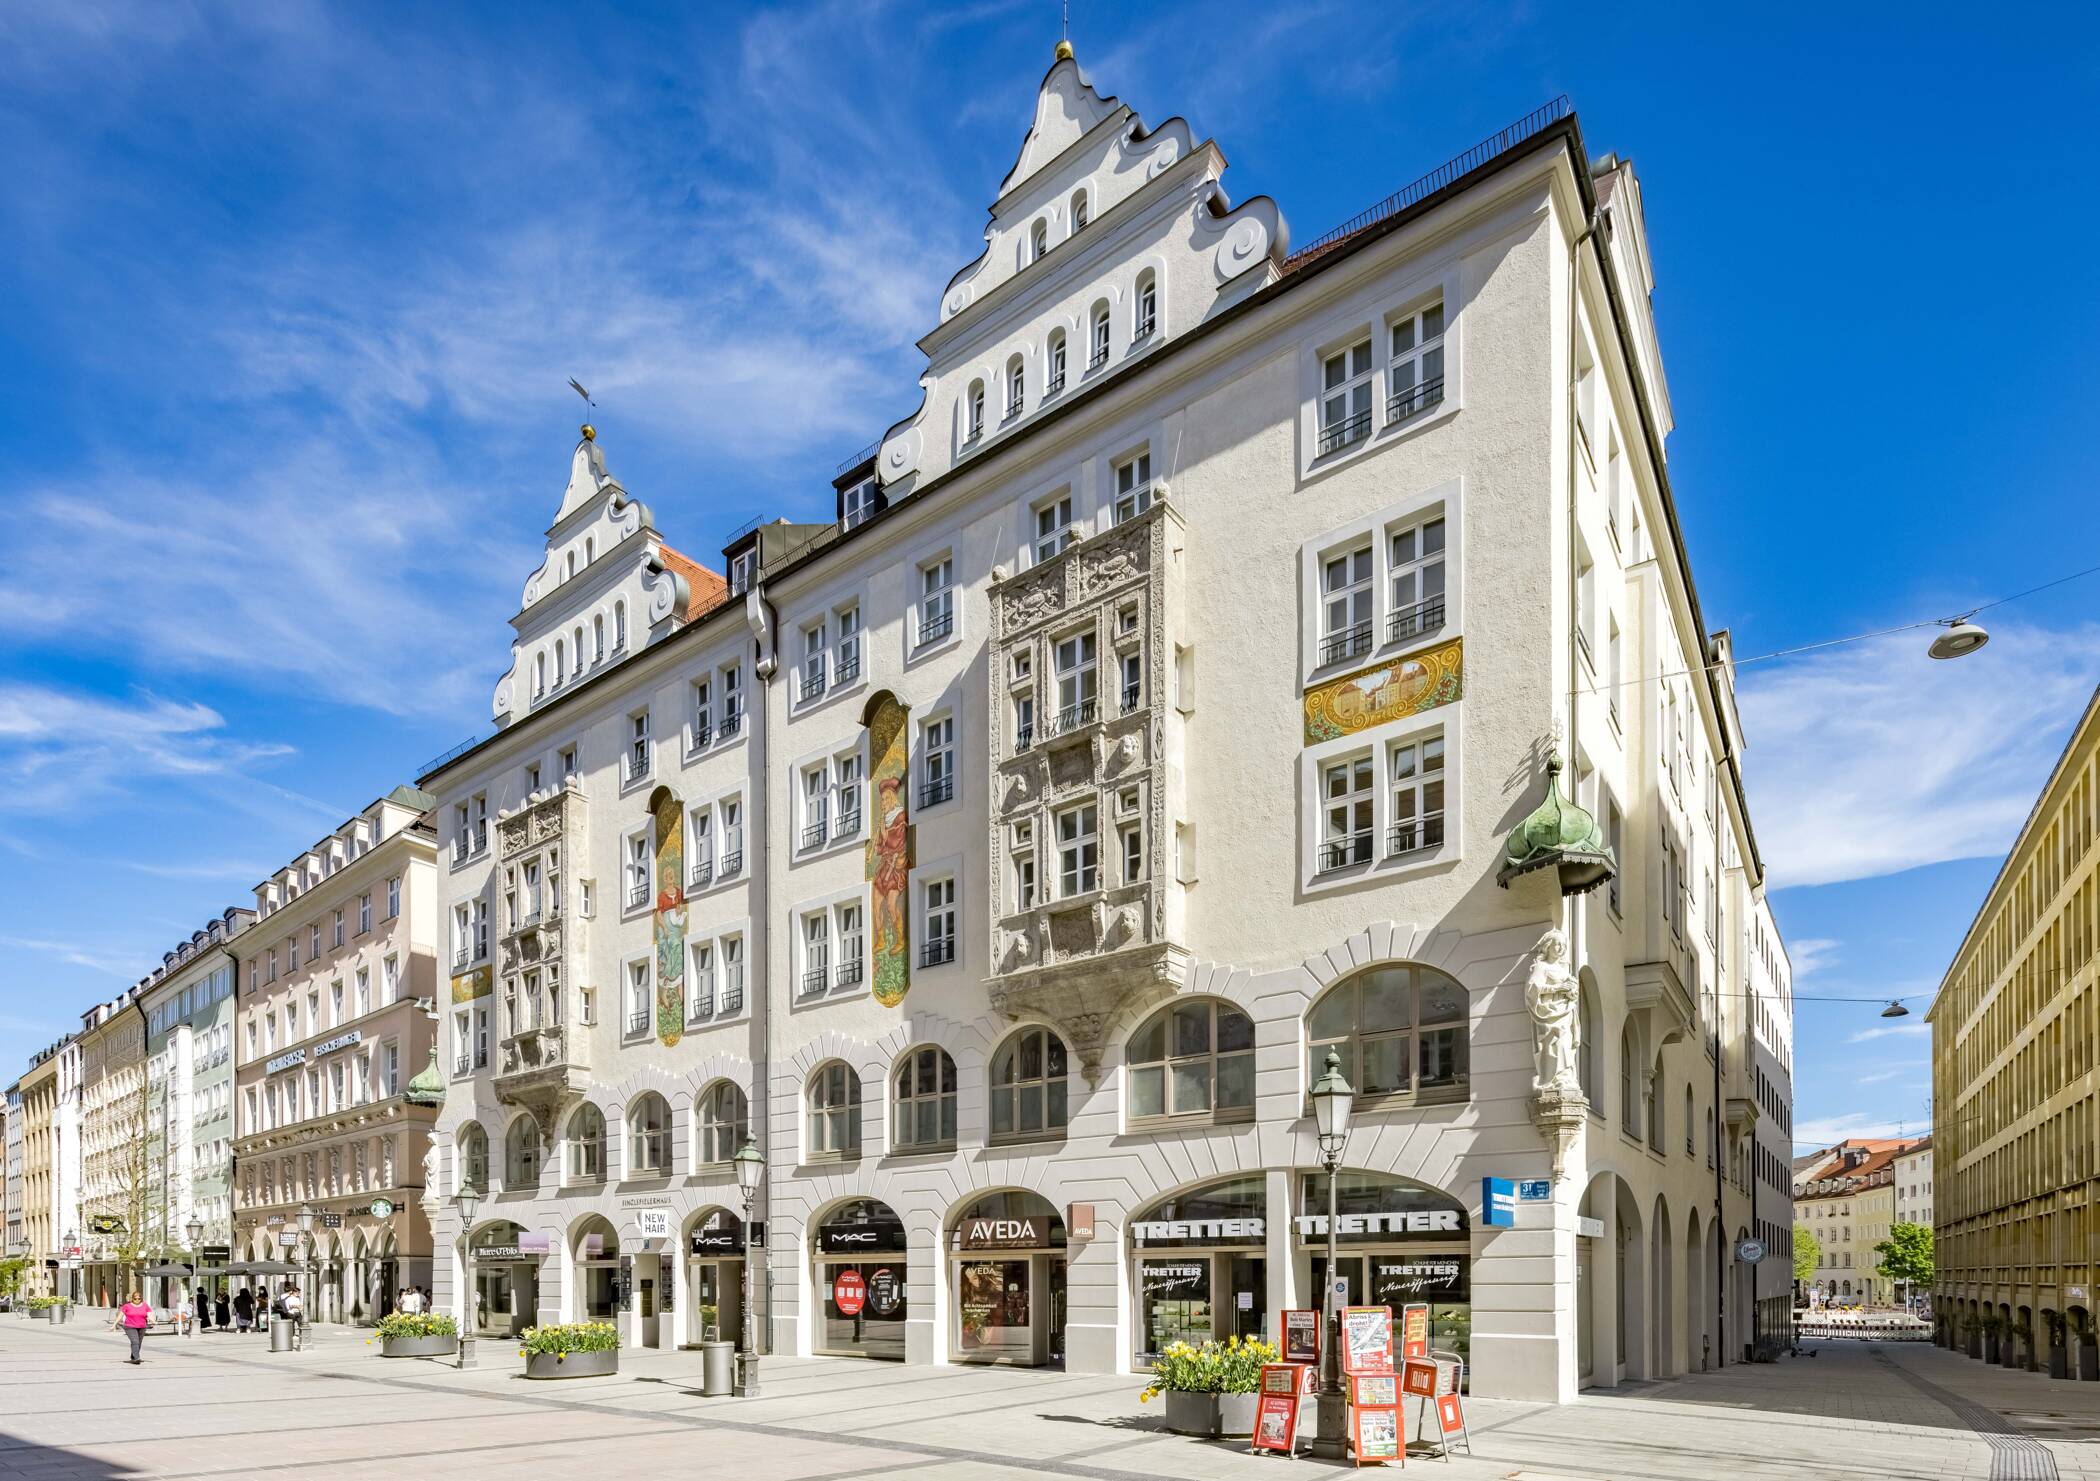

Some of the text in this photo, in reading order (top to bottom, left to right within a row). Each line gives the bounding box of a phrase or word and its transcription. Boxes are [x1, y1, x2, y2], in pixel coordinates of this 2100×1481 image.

[644, 1213, 666, 1223] NEW
[1294, 1210, 1461, 1235] TRETTER
[644, 1224, 666, 1233] HAIR
[969, 1219, 1036, 1240] AVEDA
[1074, 1227, 1093, 1235] AVEDA
[1130, 1218, 1266, 1239] TRETTER
[966, 1267, 996, 1275] AVEDA
[1142, 1267, 1202, 1277] TRETTER
[1379, 1265, 1459, 1275] TRETTER
[1379, 1273, 1459, 1293] Neueröffnung
[1411, 1370, 1429, 1389] Bild
